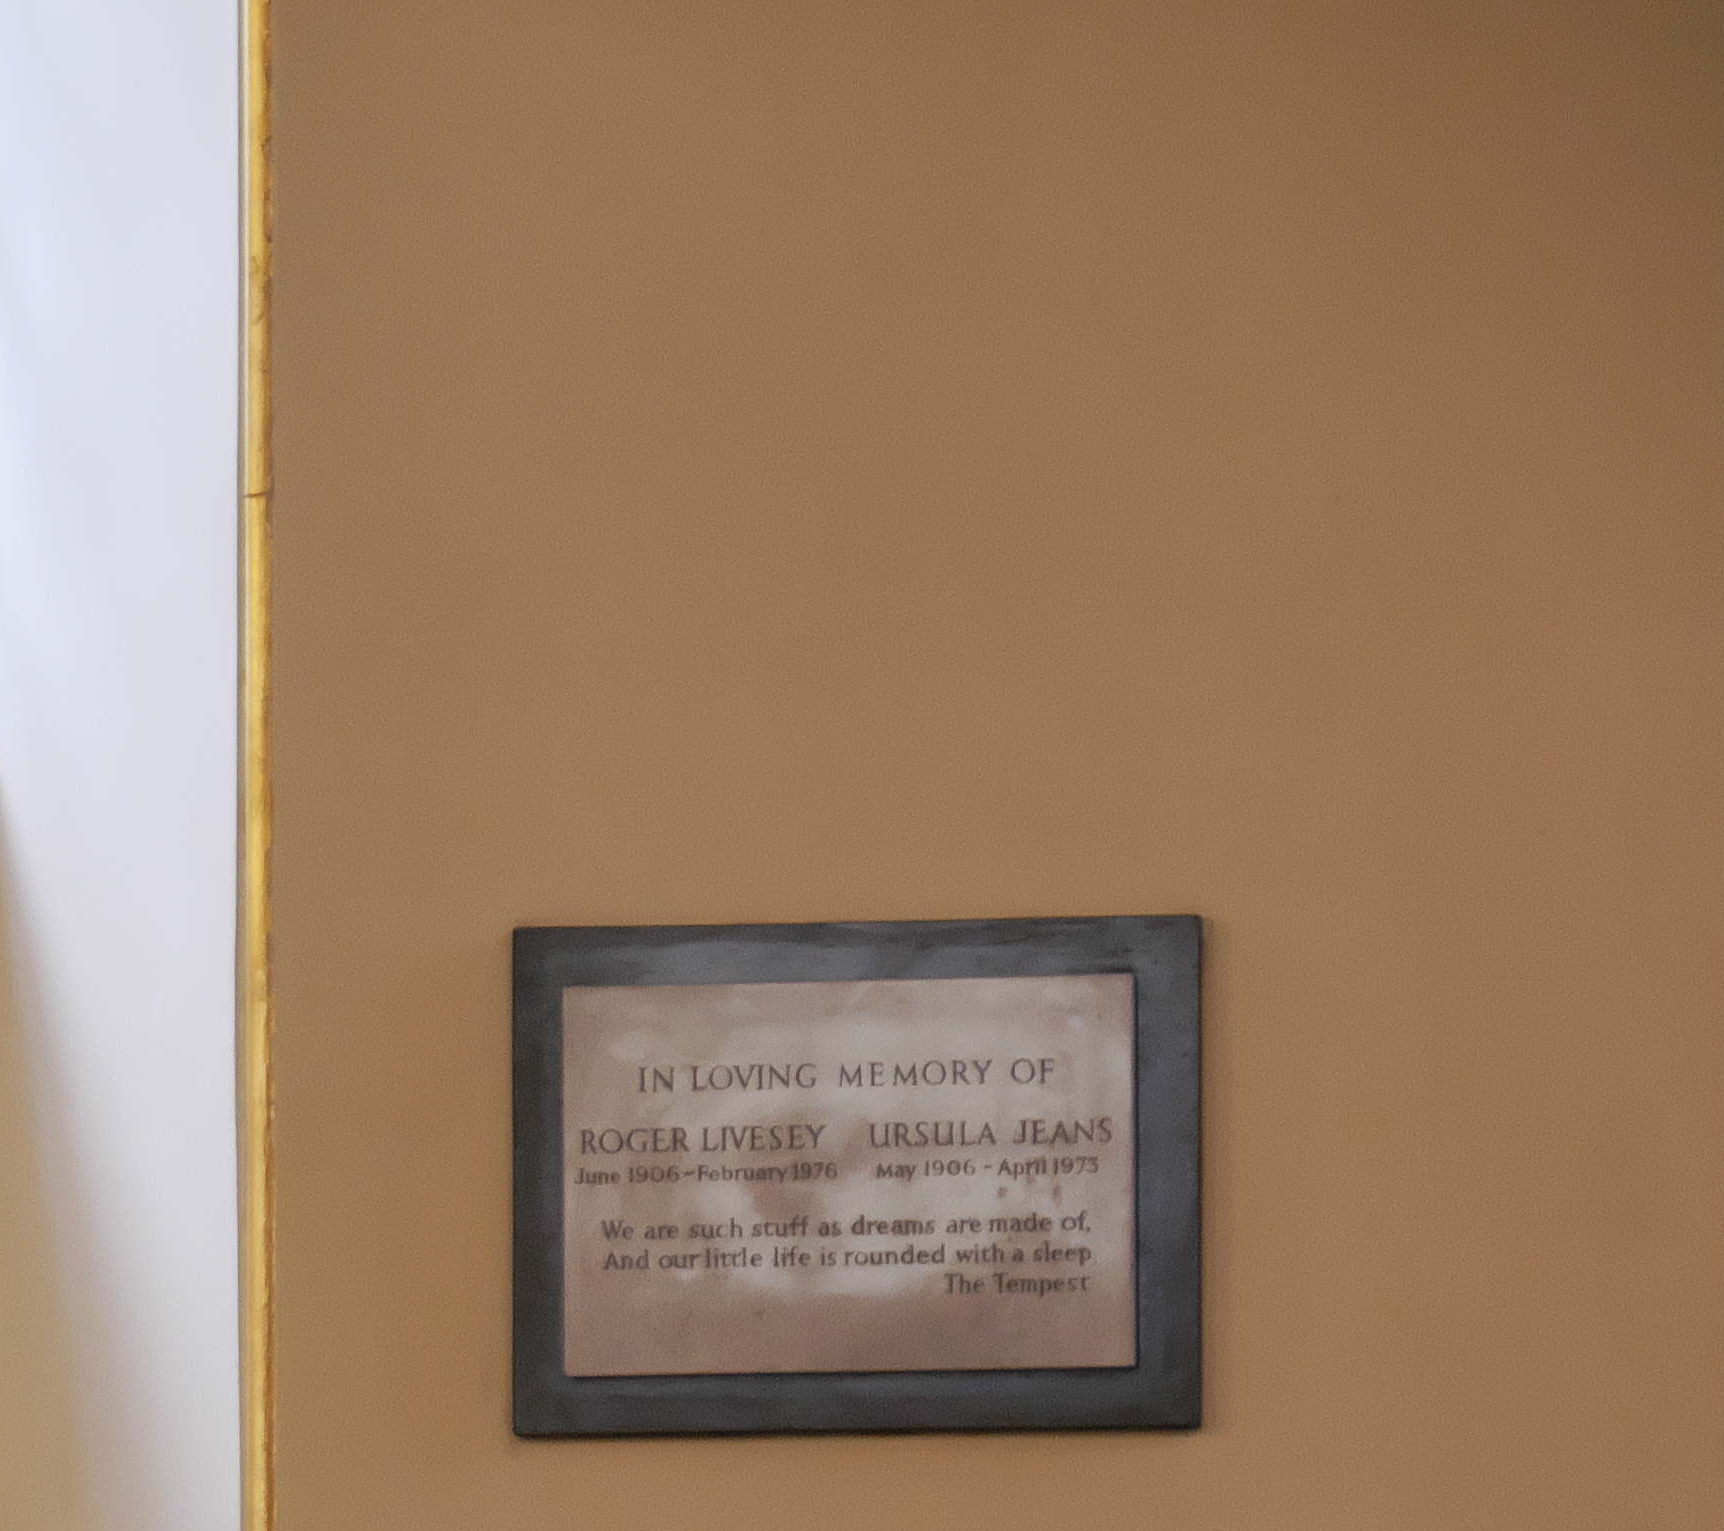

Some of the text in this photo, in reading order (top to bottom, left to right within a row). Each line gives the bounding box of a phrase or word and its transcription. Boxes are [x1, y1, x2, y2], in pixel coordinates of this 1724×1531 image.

[637, 1058, 1056, 1093] IN LOVING MEMORY OF
[580, 1125, 826, 1154] ROGER LIVESEY
[870, 1117, 1112, 1148] URSULA JEANS
[574, 1167, 620, 1185] June
[793, 1162, 837, 1181] 1976
[876, 1162, 916, 1182] May
[997, 1158, 1047, 1180] April
[601, 1219, 634, 1240] We
[644, 1223, 679, 1240] are
[689, 1217, 743, 1239] such
[751, 1215, 809, 1238] stuff
[818, 1220, 842, 1237] as
[850, 1214, 935, 1236] dreams
[945, 1218, 983, 1234] are
[988, 1212, 1053, 1233] made
[603, 1240, 1092, 1270] And our little life is rounded with a sleep
[945, 1272, 1089, 1298] The Tempest
